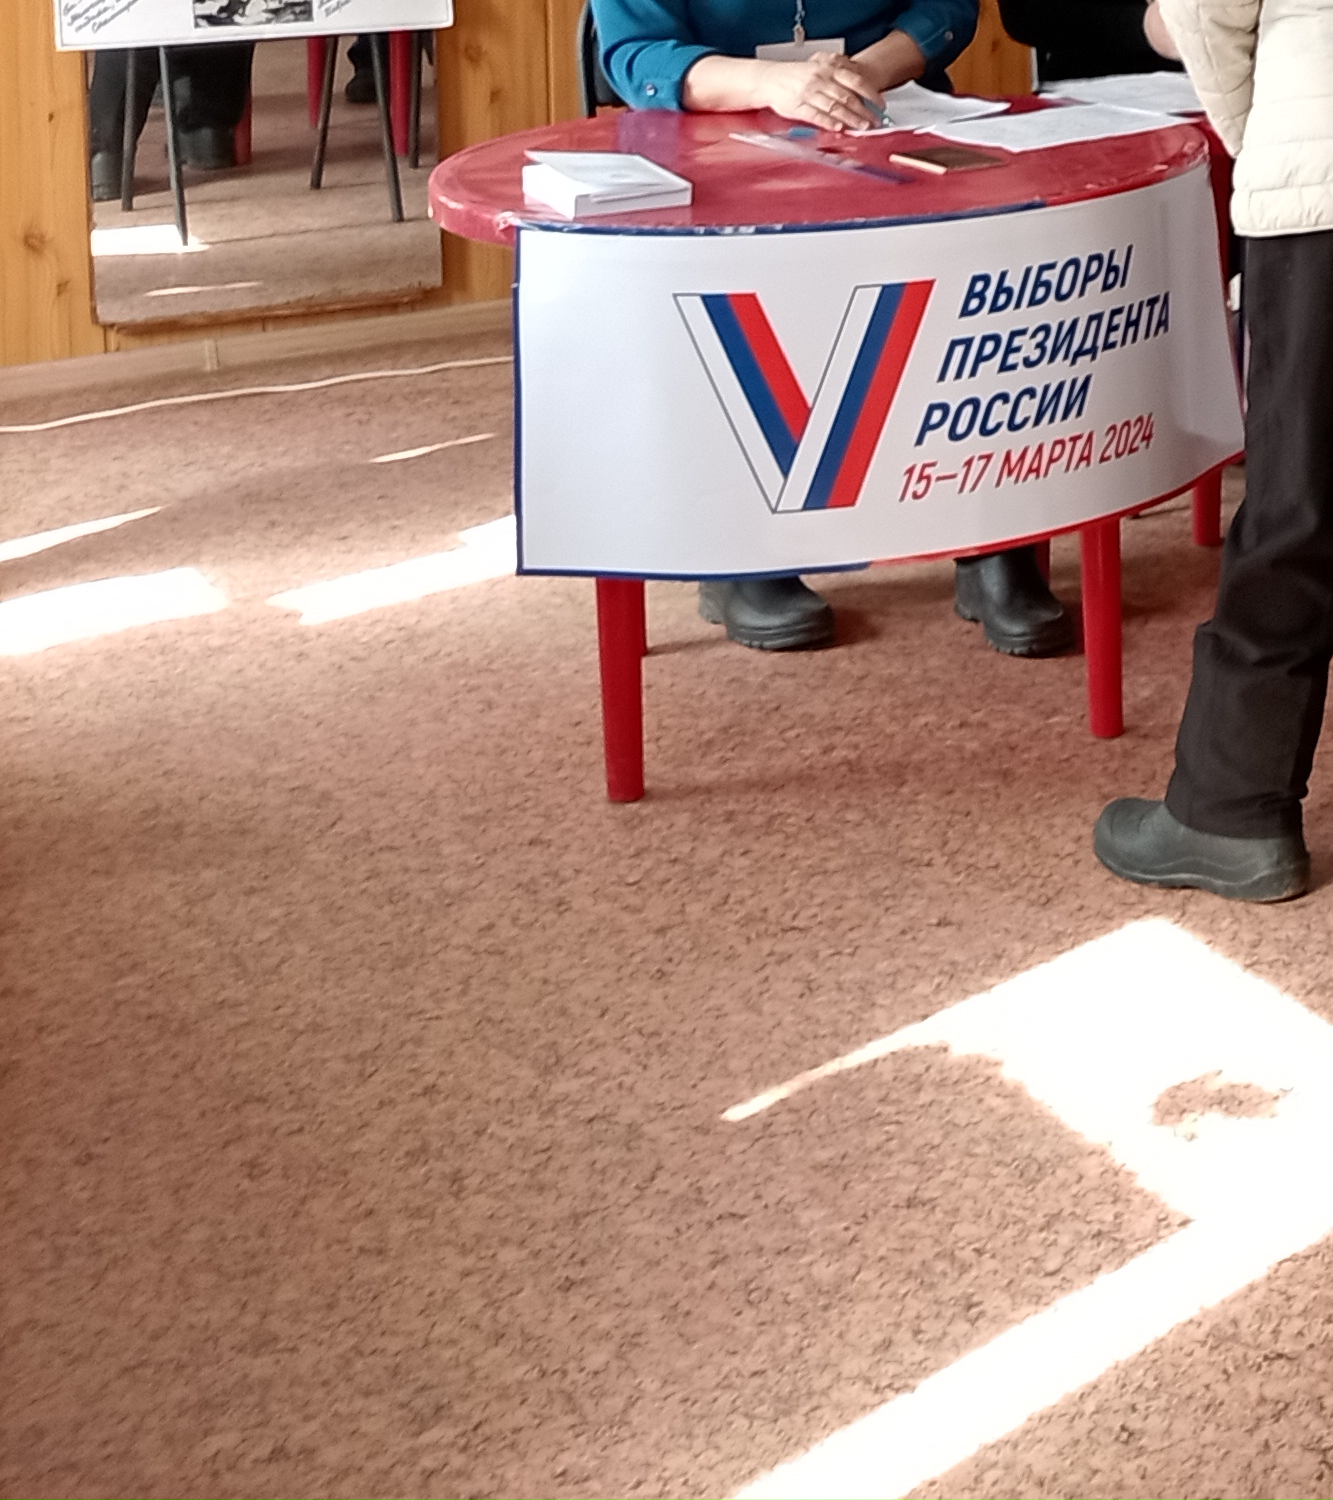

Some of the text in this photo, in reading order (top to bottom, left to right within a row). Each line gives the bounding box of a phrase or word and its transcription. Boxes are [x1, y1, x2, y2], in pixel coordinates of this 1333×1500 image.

[957, 244, 1135, 320] ВЫБОРЫ
[935, 291, 1171, 384] ПРЕЗИДЕНТА
[913, 374, 1092, 447] РОССИИ
[999, 429, 1098, 487] МАРТА
[1098, 412, 1156, 465] 2024
